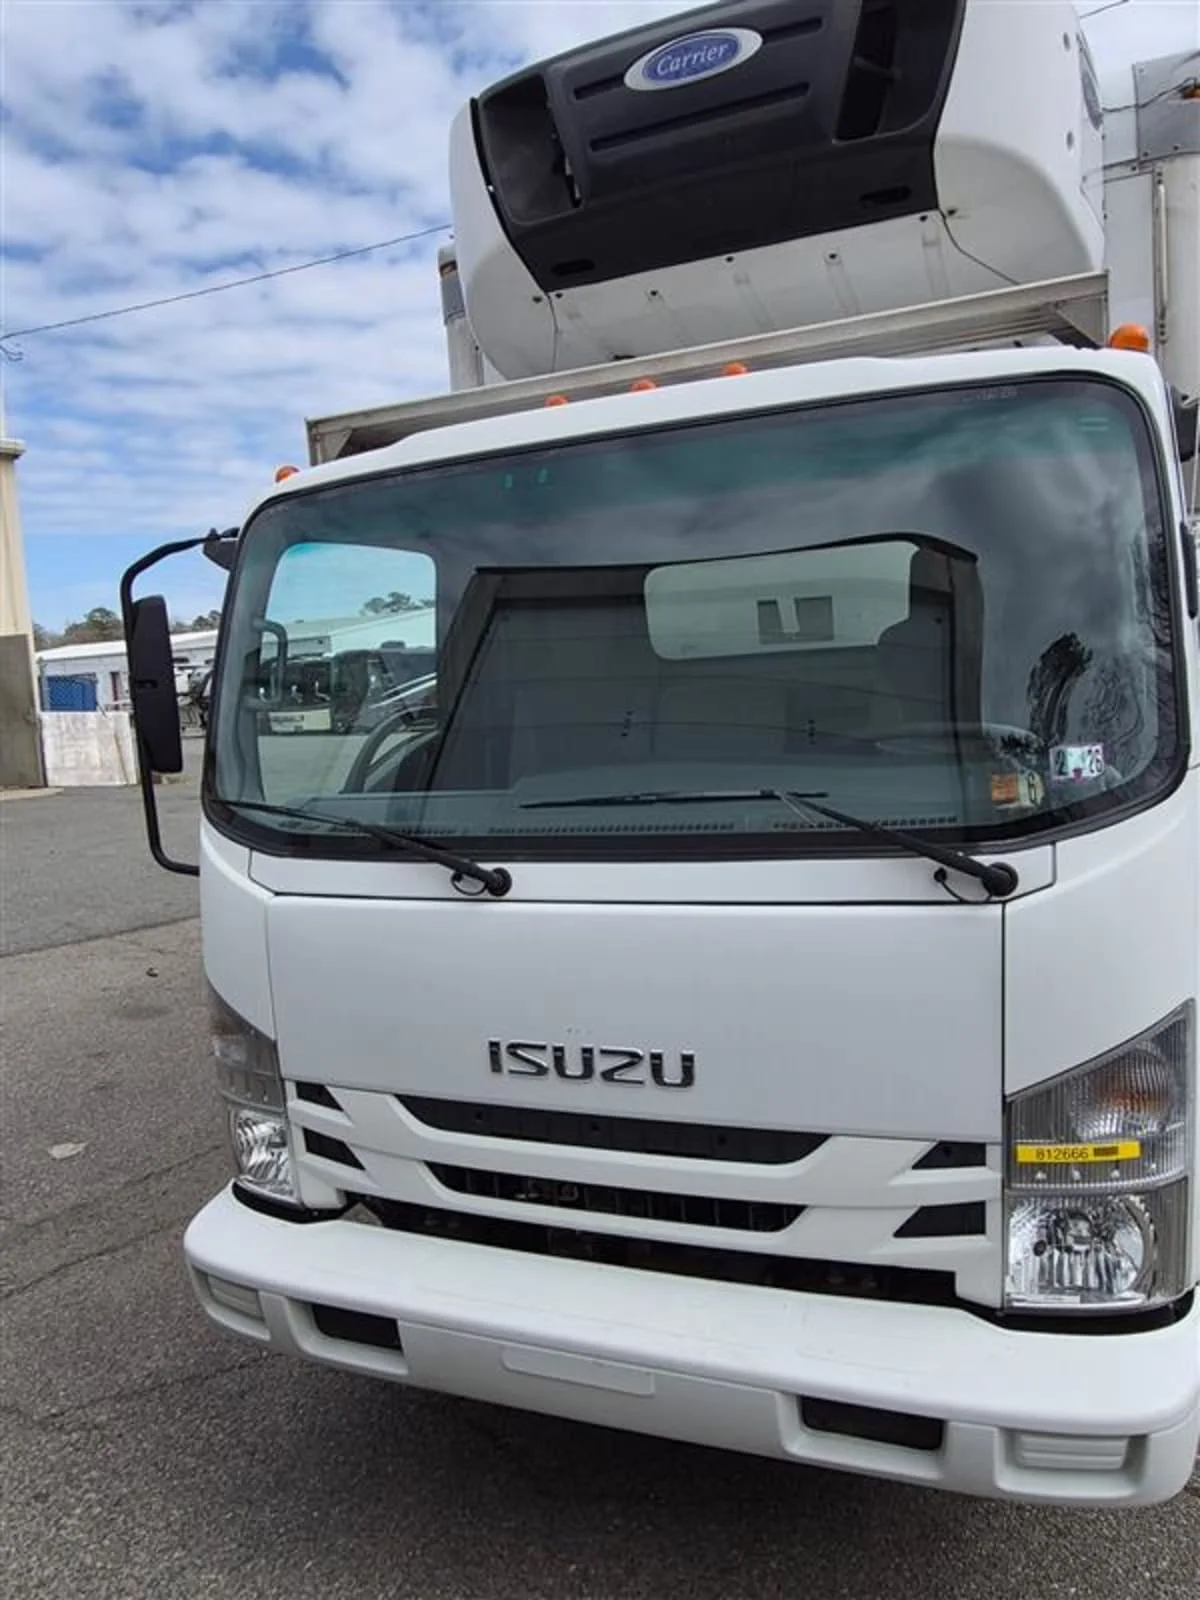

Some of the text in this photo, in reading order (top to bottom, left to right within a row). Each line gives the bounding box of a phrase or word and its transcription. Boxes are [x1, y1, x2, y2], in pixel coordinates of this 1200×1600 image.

[656, 42, 730, 76] Carrier
[488, 1037, 695, 1088] ISUZU
[1035, 1146, 1089, 1161] 812666
